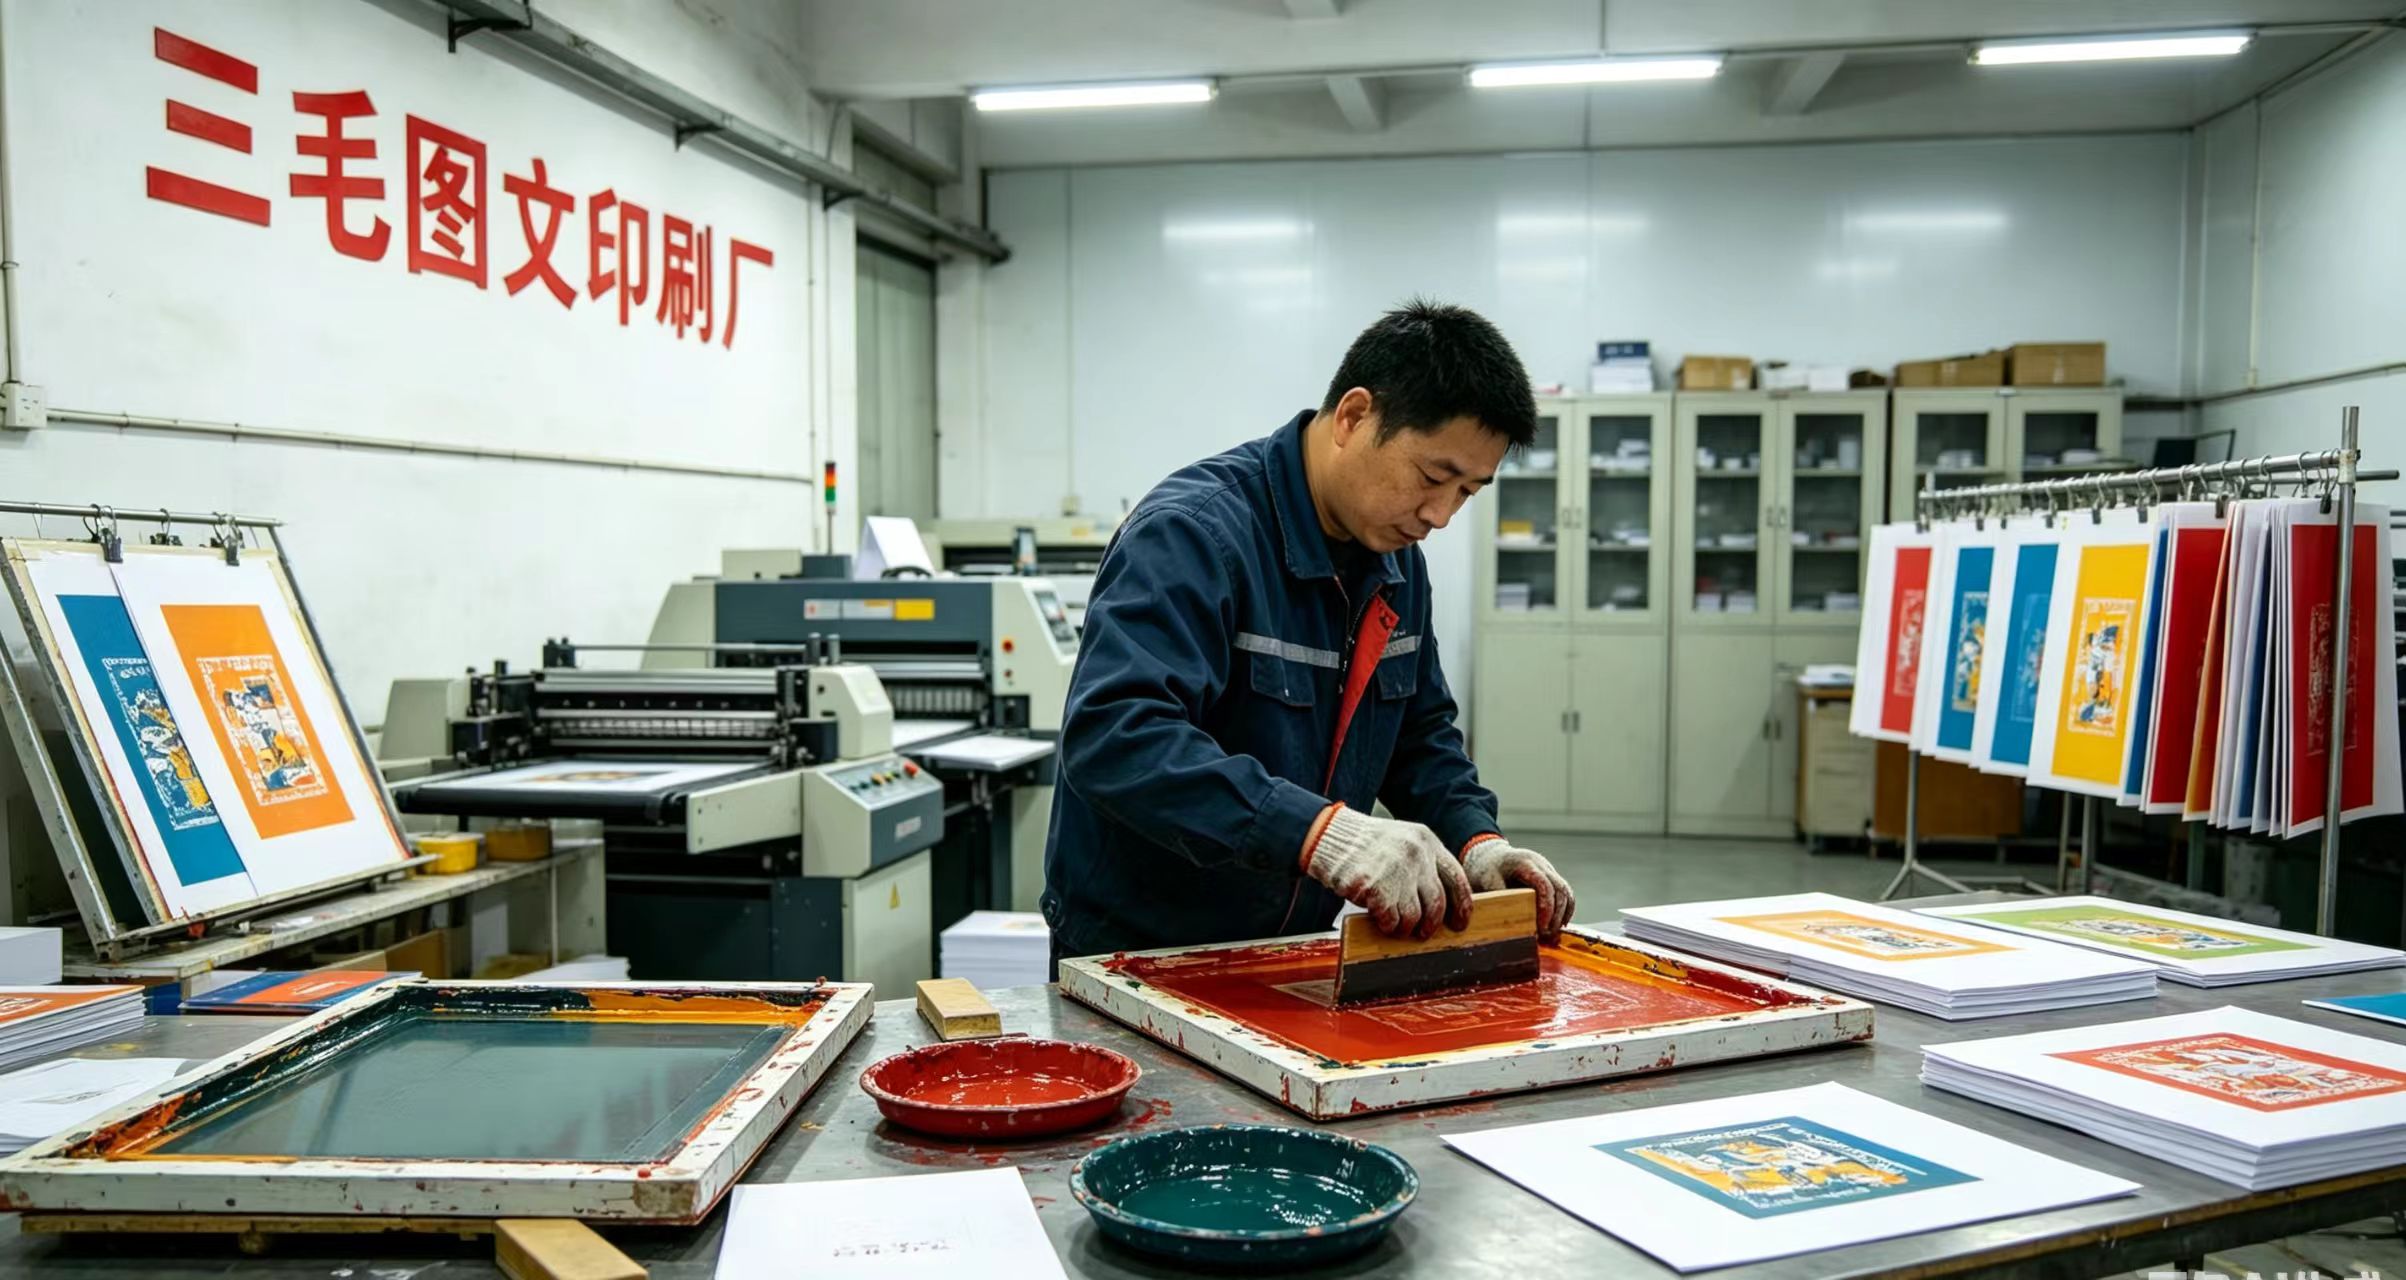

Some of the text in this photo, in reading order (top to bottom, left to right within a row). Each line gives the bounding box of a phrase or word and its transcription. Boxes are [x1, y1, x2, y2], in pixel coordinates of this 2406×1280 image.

[146, 27, 774, 349] 三毛图文印刷厂
